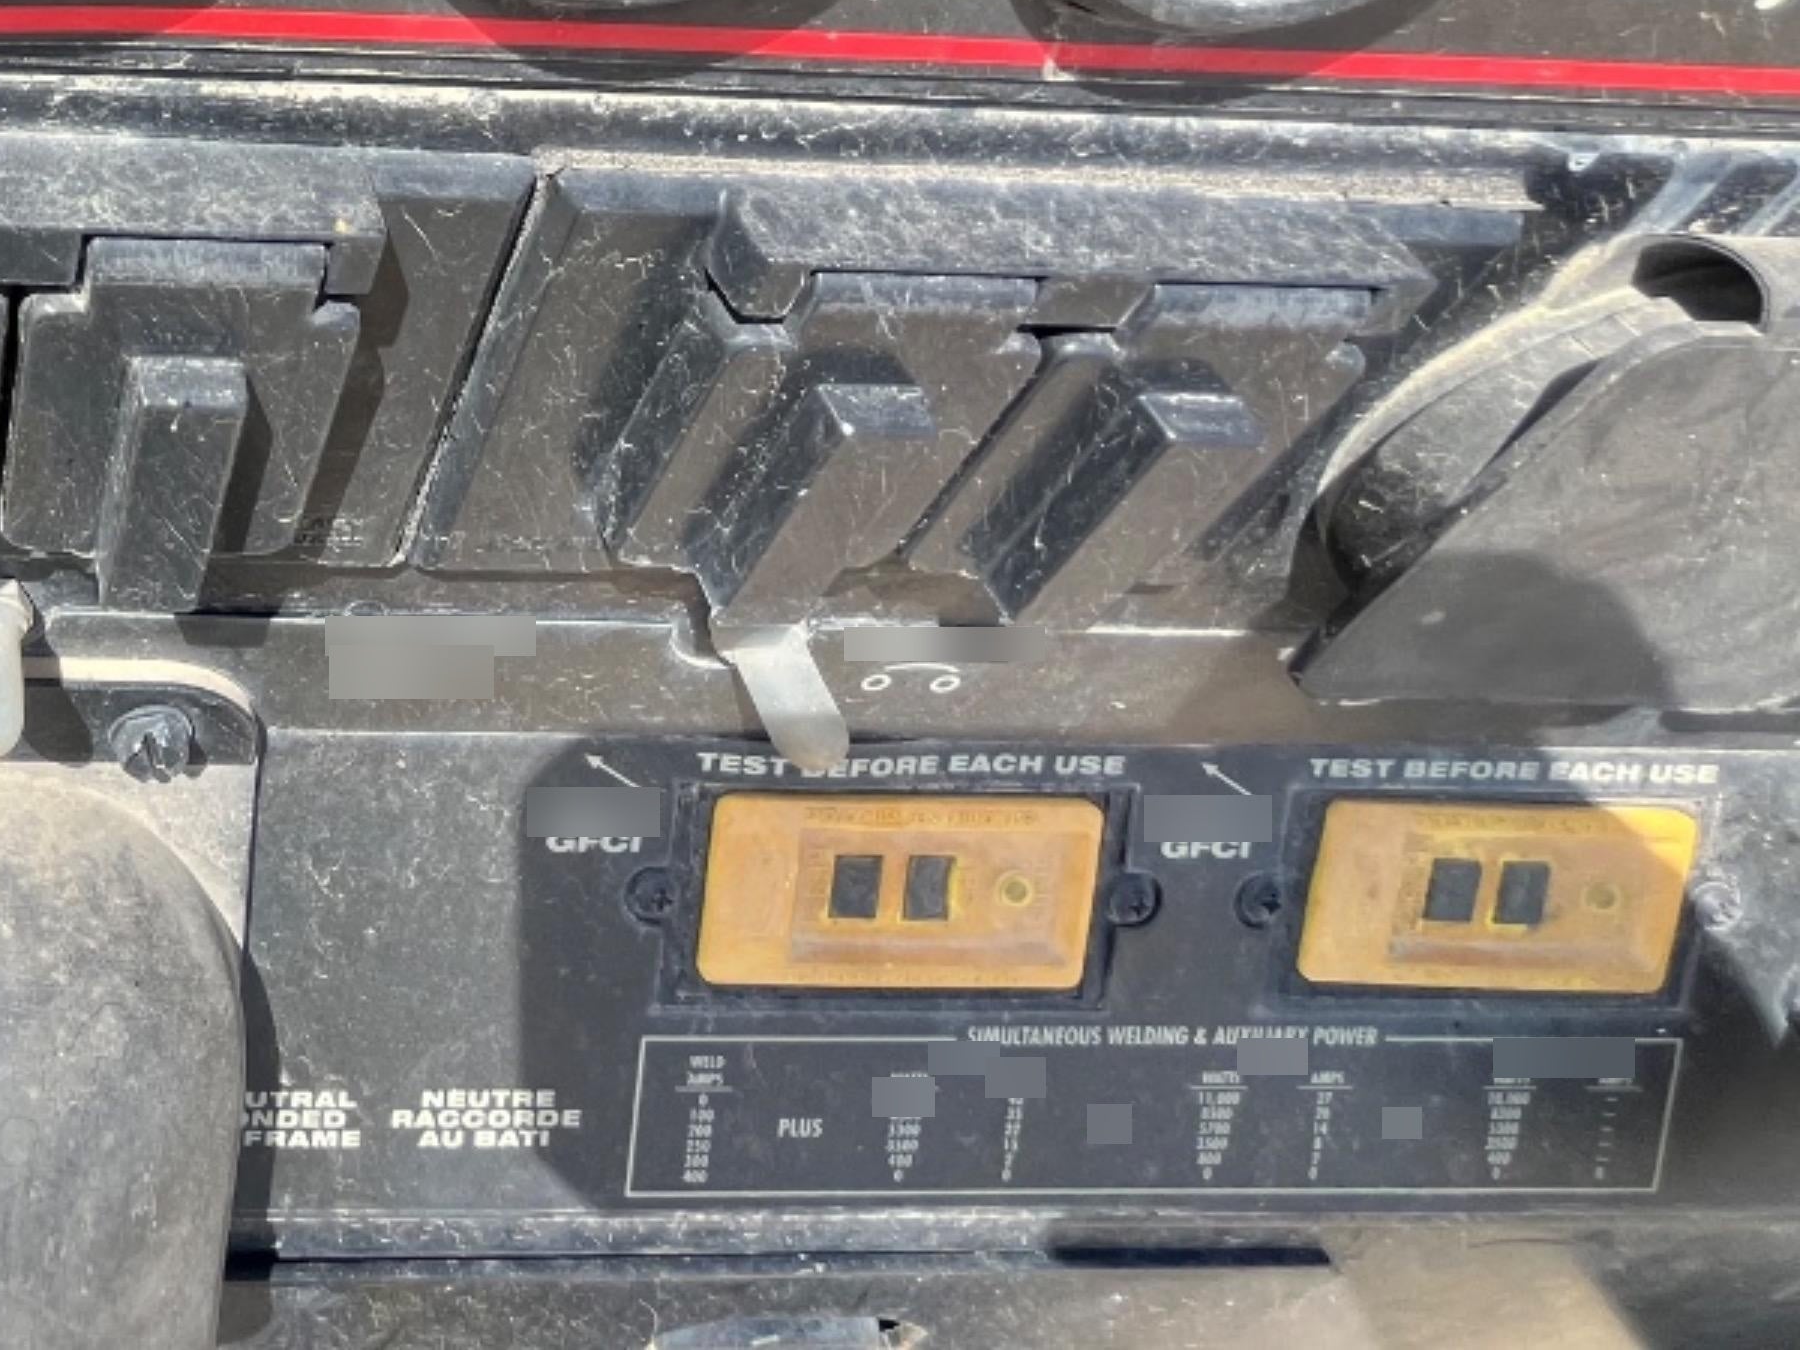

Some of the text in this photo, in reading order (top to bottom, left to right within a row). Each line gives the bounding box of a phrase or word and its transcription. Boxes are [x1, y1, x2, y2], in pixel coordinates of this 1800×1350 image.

[699, 752, 787, 778] TEST
[949, 753, 1050, 776] EACH
[1056, 754, 1126, 778] USE
[1310, 757, 1720, 786] TEST BEFORE EACH USE
[1107, 1026, 1189, 1045] WELDING
[1313, 1026, 1379, 1046] POWER
[245, 1091, 358, 1109] UTRAL
[240, 1110, 346, 1129] NDED
[777, 1117, 824, 1138] PLUS
[243, 1130, 361, 1148] FRAME
[417, 1130, 551, 1148] AU BATI
